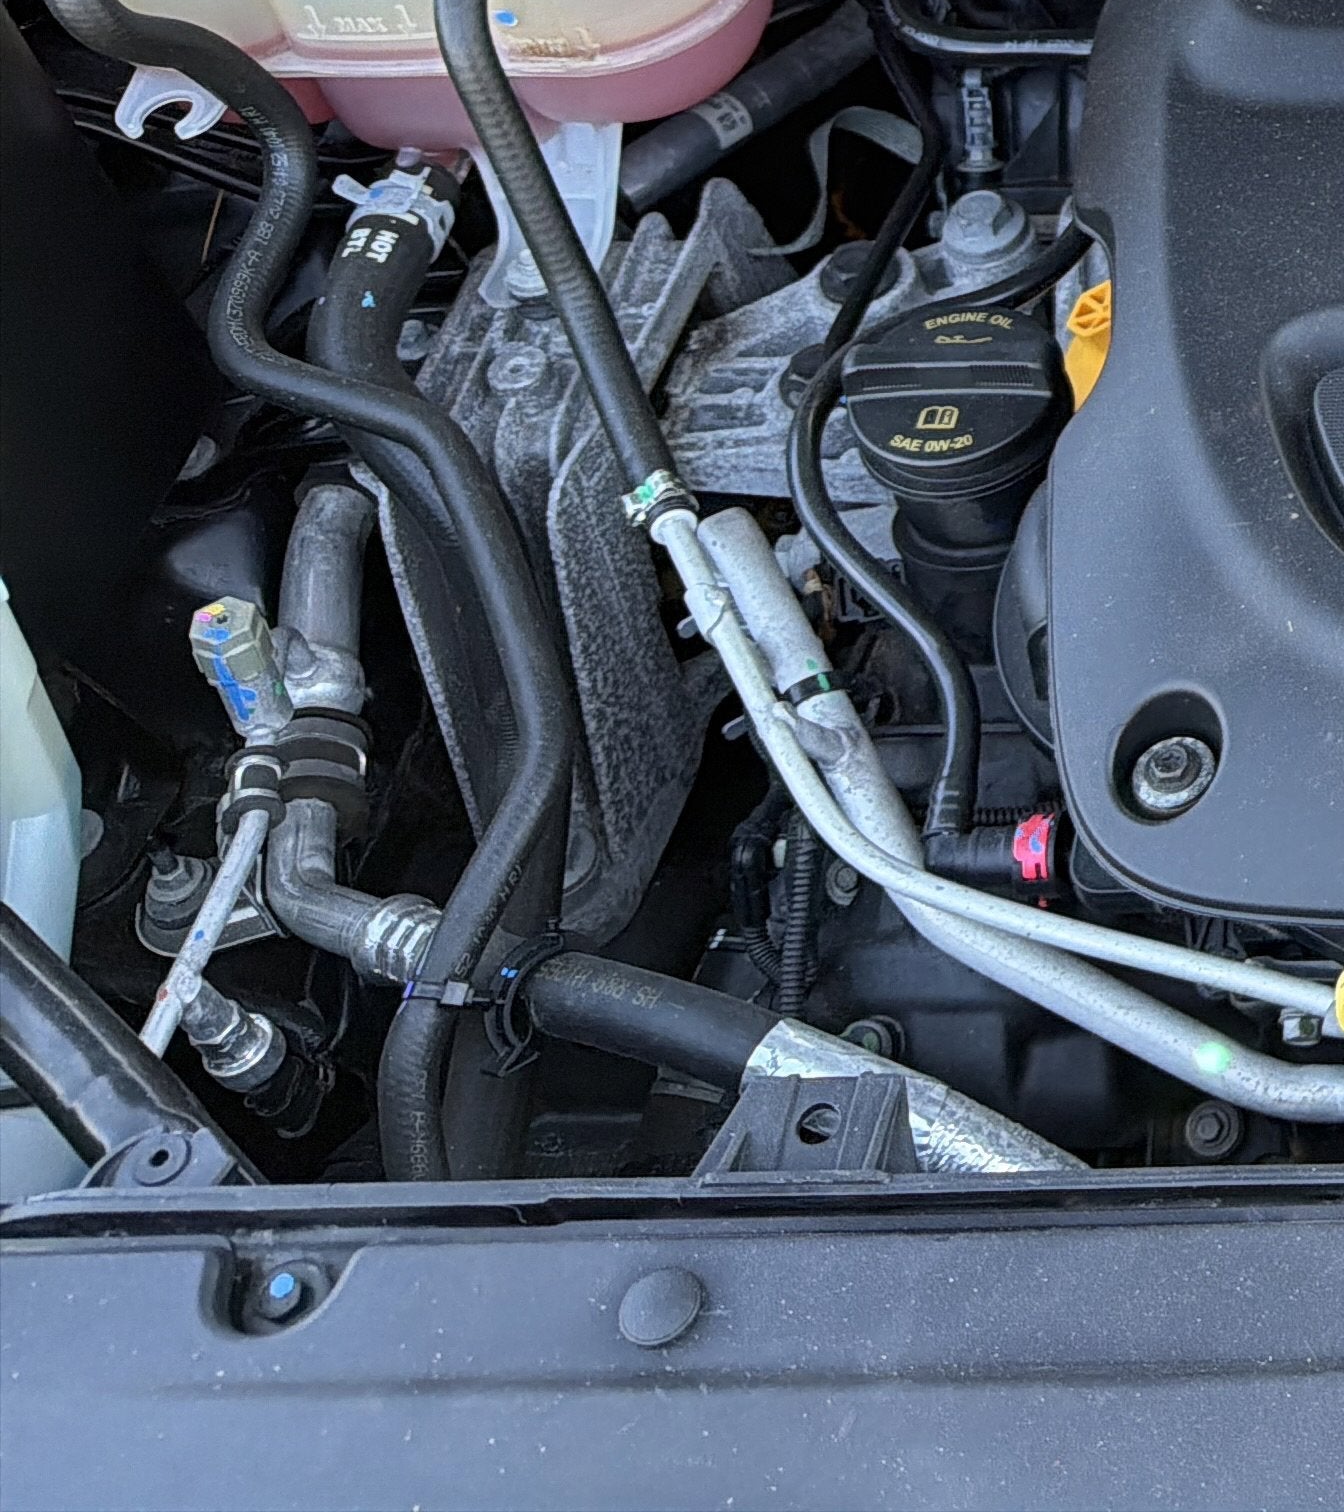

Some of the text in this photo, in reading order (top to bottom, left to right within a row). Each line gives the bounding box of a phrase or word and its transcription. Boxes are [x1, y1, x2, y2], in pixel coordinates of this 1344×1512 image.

[366, 229, 400, 263] HOT
[923, 312, 1014, 330] ENGINE OIL
[889, 434, 974, 453] SAE 0W-20
